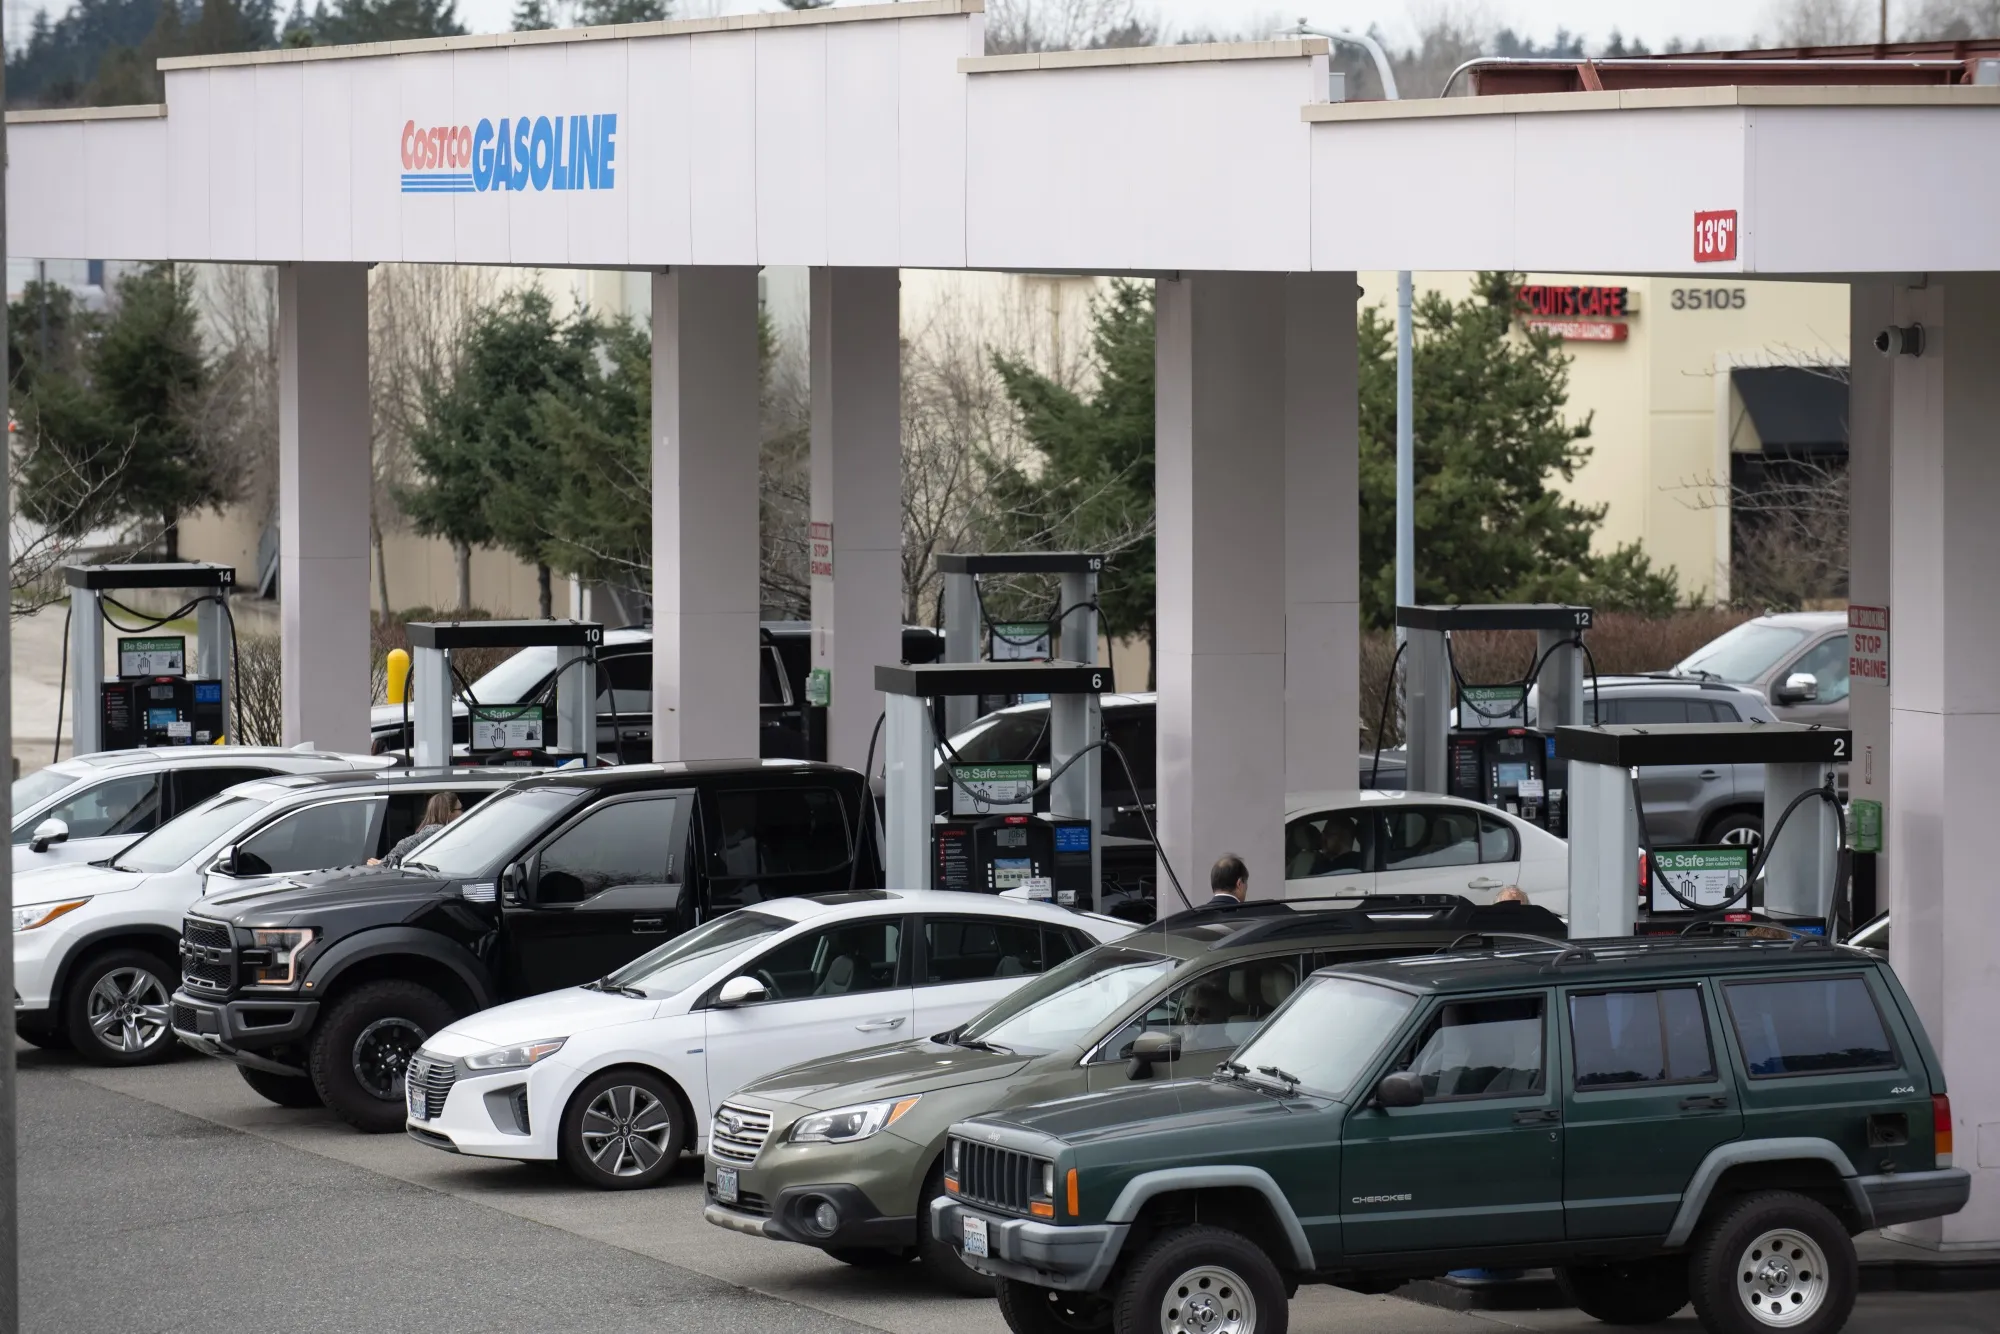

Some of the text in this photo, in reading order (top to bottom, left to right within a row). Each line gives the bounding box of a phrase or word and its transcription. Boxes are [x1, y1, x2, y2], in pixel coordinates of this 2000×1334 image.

[472, 113, 617, 192] GASOLINE
[1696, 218, 1733, 253] 13'6"
[1577, 286, 1621, 316] CAFE
[1671, 288, 1746, 311] 35105
[813, 543, 829, 557] STOP
[811, 560, 832, 576] ENGINE
[1088, 558, 1101, 570] 16
[219, 571, 231, 582] 14
[1574, 612, 1589, 625] 12
[585, 629, 600, 642] 10
[123, 642, 135, 650] Be
[136, 641, 156, 650] Safe
[1855, 633, 1881, 653] STOP
[1849, 657, 1887, 679] ENGINE
[1092, 673, 1102, 689] 6
[1476, 690, 1495, 699] Safe
[1833, 738, 1845, 756] 2
[955, 768, 997, 779] Be Safe
[1655, 854, 1705, 868] Be Safe
[1352, 1193, 1412, 1204] CHEROKEE
